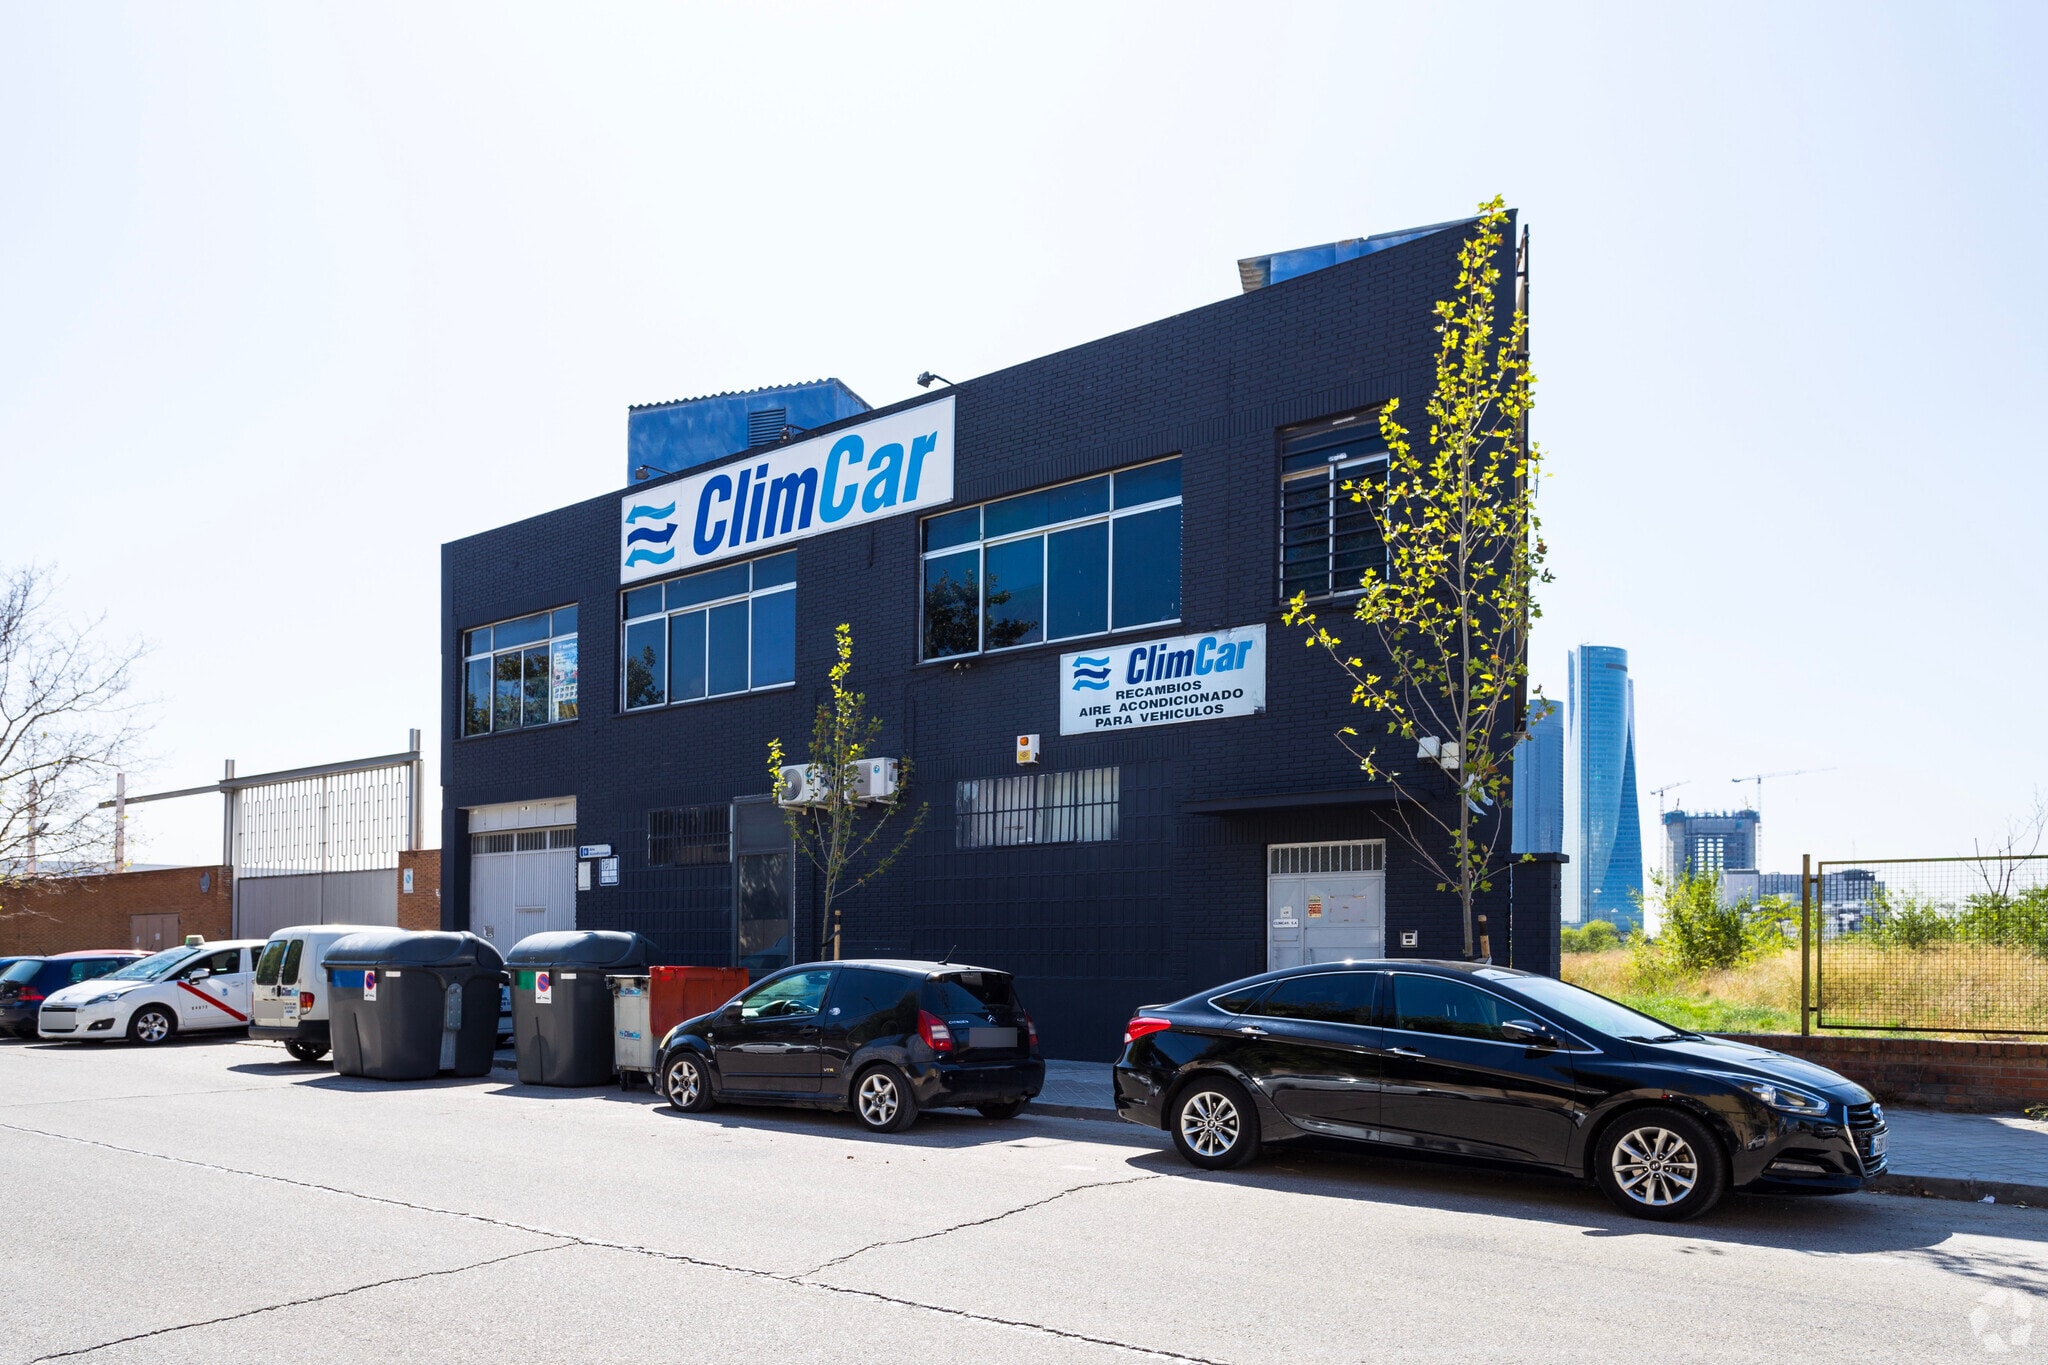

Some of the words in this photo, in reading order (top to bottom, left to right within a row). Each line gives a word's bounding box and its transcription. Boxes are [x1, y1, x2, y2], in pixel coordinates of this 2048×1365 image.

[693, 430, 938, 556] ClimCar
[1125, 636, 1253, 685] ClimCar
[1079, 705, 1112, 717] AIRE
[1119, 688, 1244, 712] ACONDICIONADO
[1115, 680, 1202, 700] RECAMBIOS
[1095, 715, 1133, 728] PARA
[1140, 704, 1225, 723] VEHICULOS
